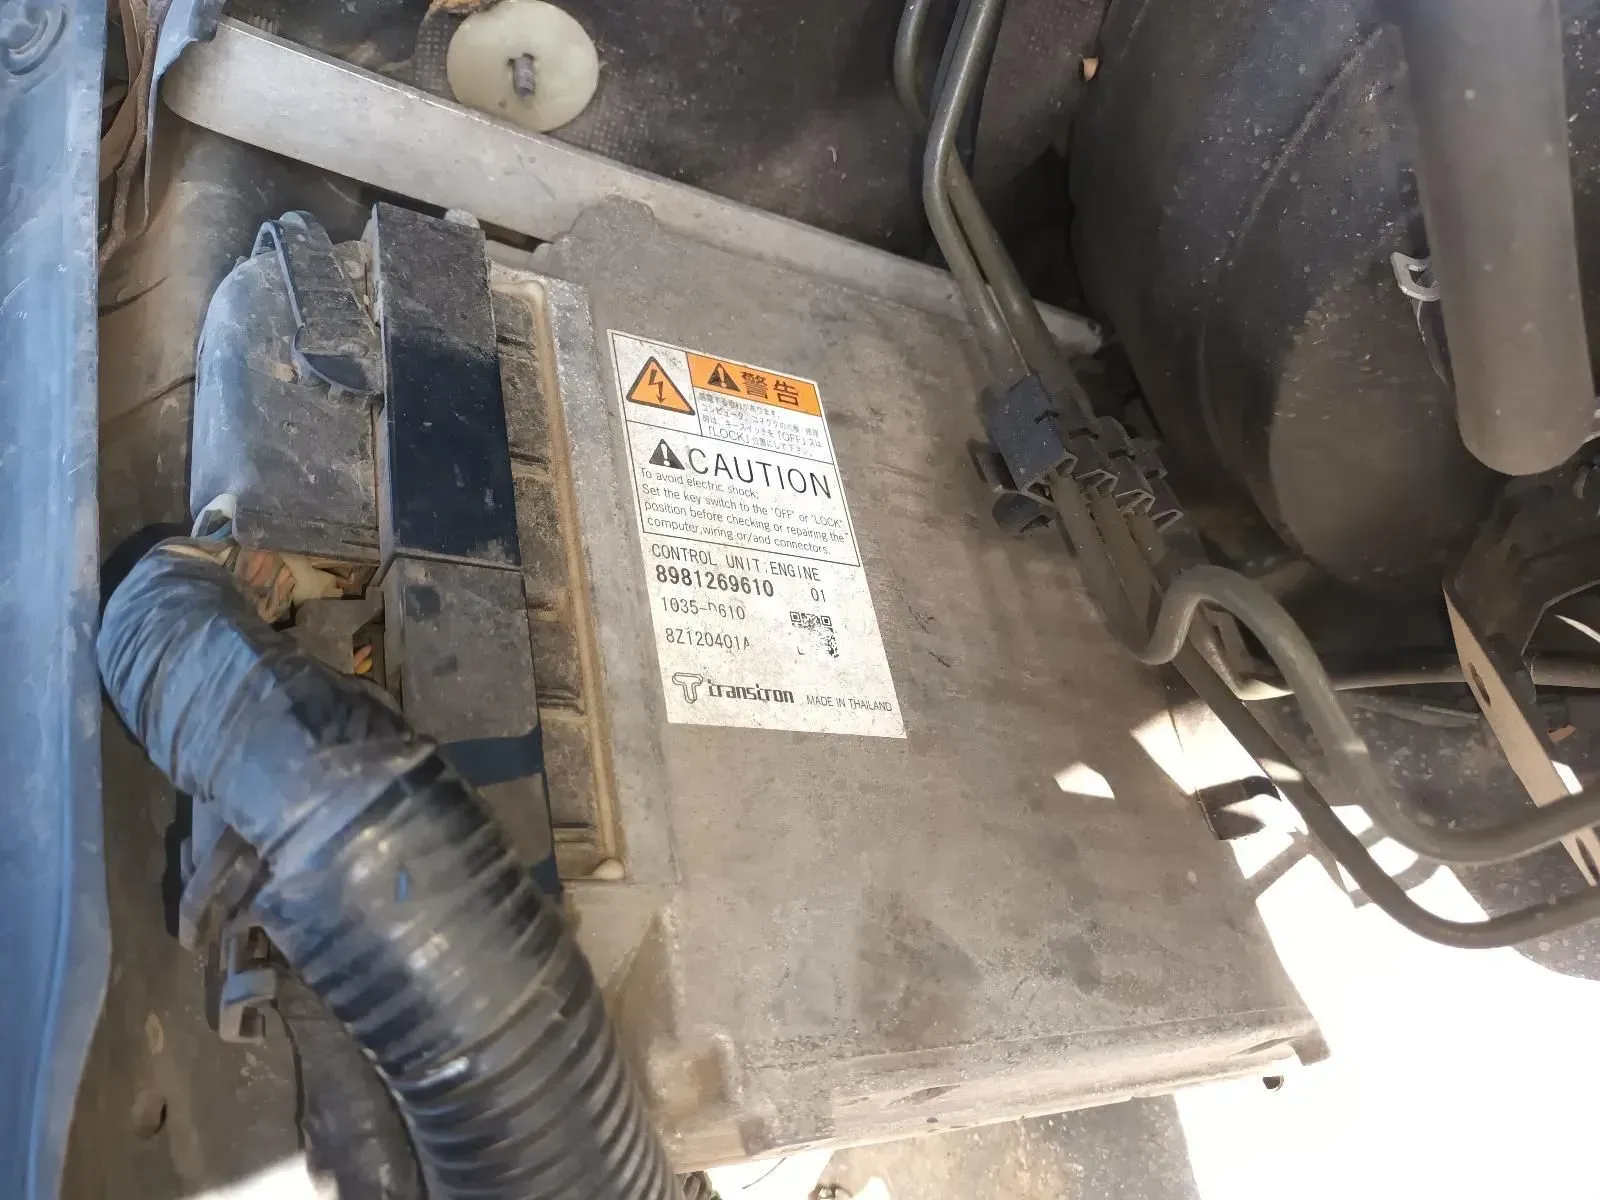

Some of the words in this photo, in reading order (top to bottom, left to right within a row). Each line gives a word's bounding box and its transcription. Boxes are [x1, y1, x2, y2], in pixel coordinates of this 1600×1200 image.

[740, 371, 799, 407] 警告
[641, 467, 653, 479] To
[656, 472, 684, 485] avoid
[686, 477, 724, 492] electric
[689, 448, 831, 499] CAUTION
[642, 483, 661, 497] Set
[663, 487, 681, 500] the
[683, 491, 702, 505] key
[705, 496, 737, 509] switch
[739, 502, 750, 512] to
[752, 503, 768, 516] the
[799, 514, 809, 523] or
[644, 501, 687, 516] position
[689, 506, 724, 522] before
[726, 514, 771, 533] checking
[773, 523, 784, 533] or
[786, 526, 829, 543] repairing
[829, 531, 845, 544] the
[651, 543, 717, 566] CONTROL
[736, 532, 771, 545] or/and
[774, 538, 832, 555] connectors.
[655, 564, 774, 597] 8981269610
[810, 587, 826, 603] 01
[806, 694, 834, 707] MADE
[836, 698, 846, 708] IN
[847, 698, 893, 712] THAILAND
